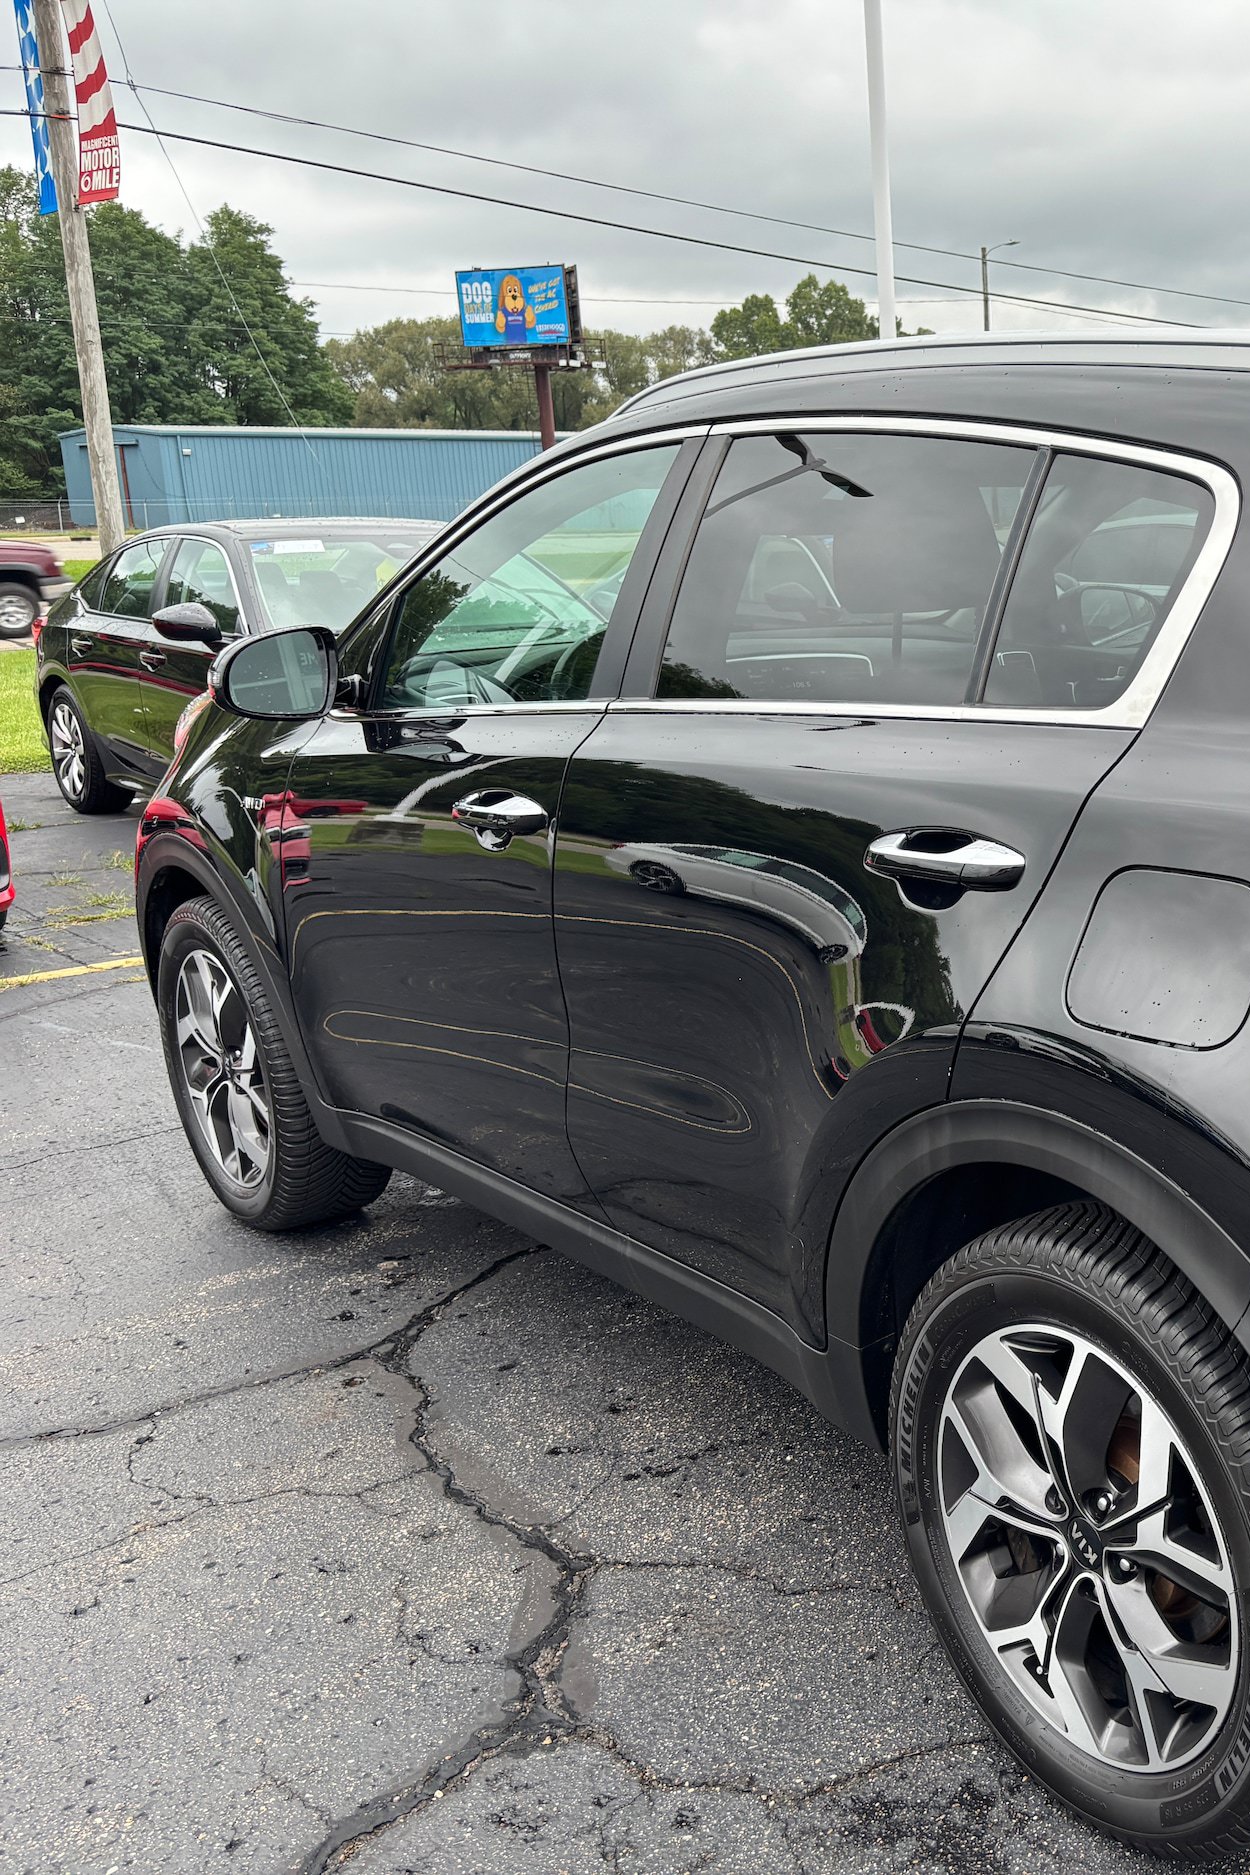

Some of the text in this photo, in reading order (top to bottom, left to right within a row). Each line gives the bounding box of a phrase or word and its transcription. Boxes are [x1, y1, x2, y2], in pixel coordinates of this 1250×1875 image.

[81, 146, 120, 172] MOTOR
[92, 168, 119, 190] MILE
[461, 281, 493, 304] DOG
[464, 312, 495, 324] SUMMER
[900, 1335, 935, 1475] MICHELIN
[1072, 1521, 1098, 1566] KIA
